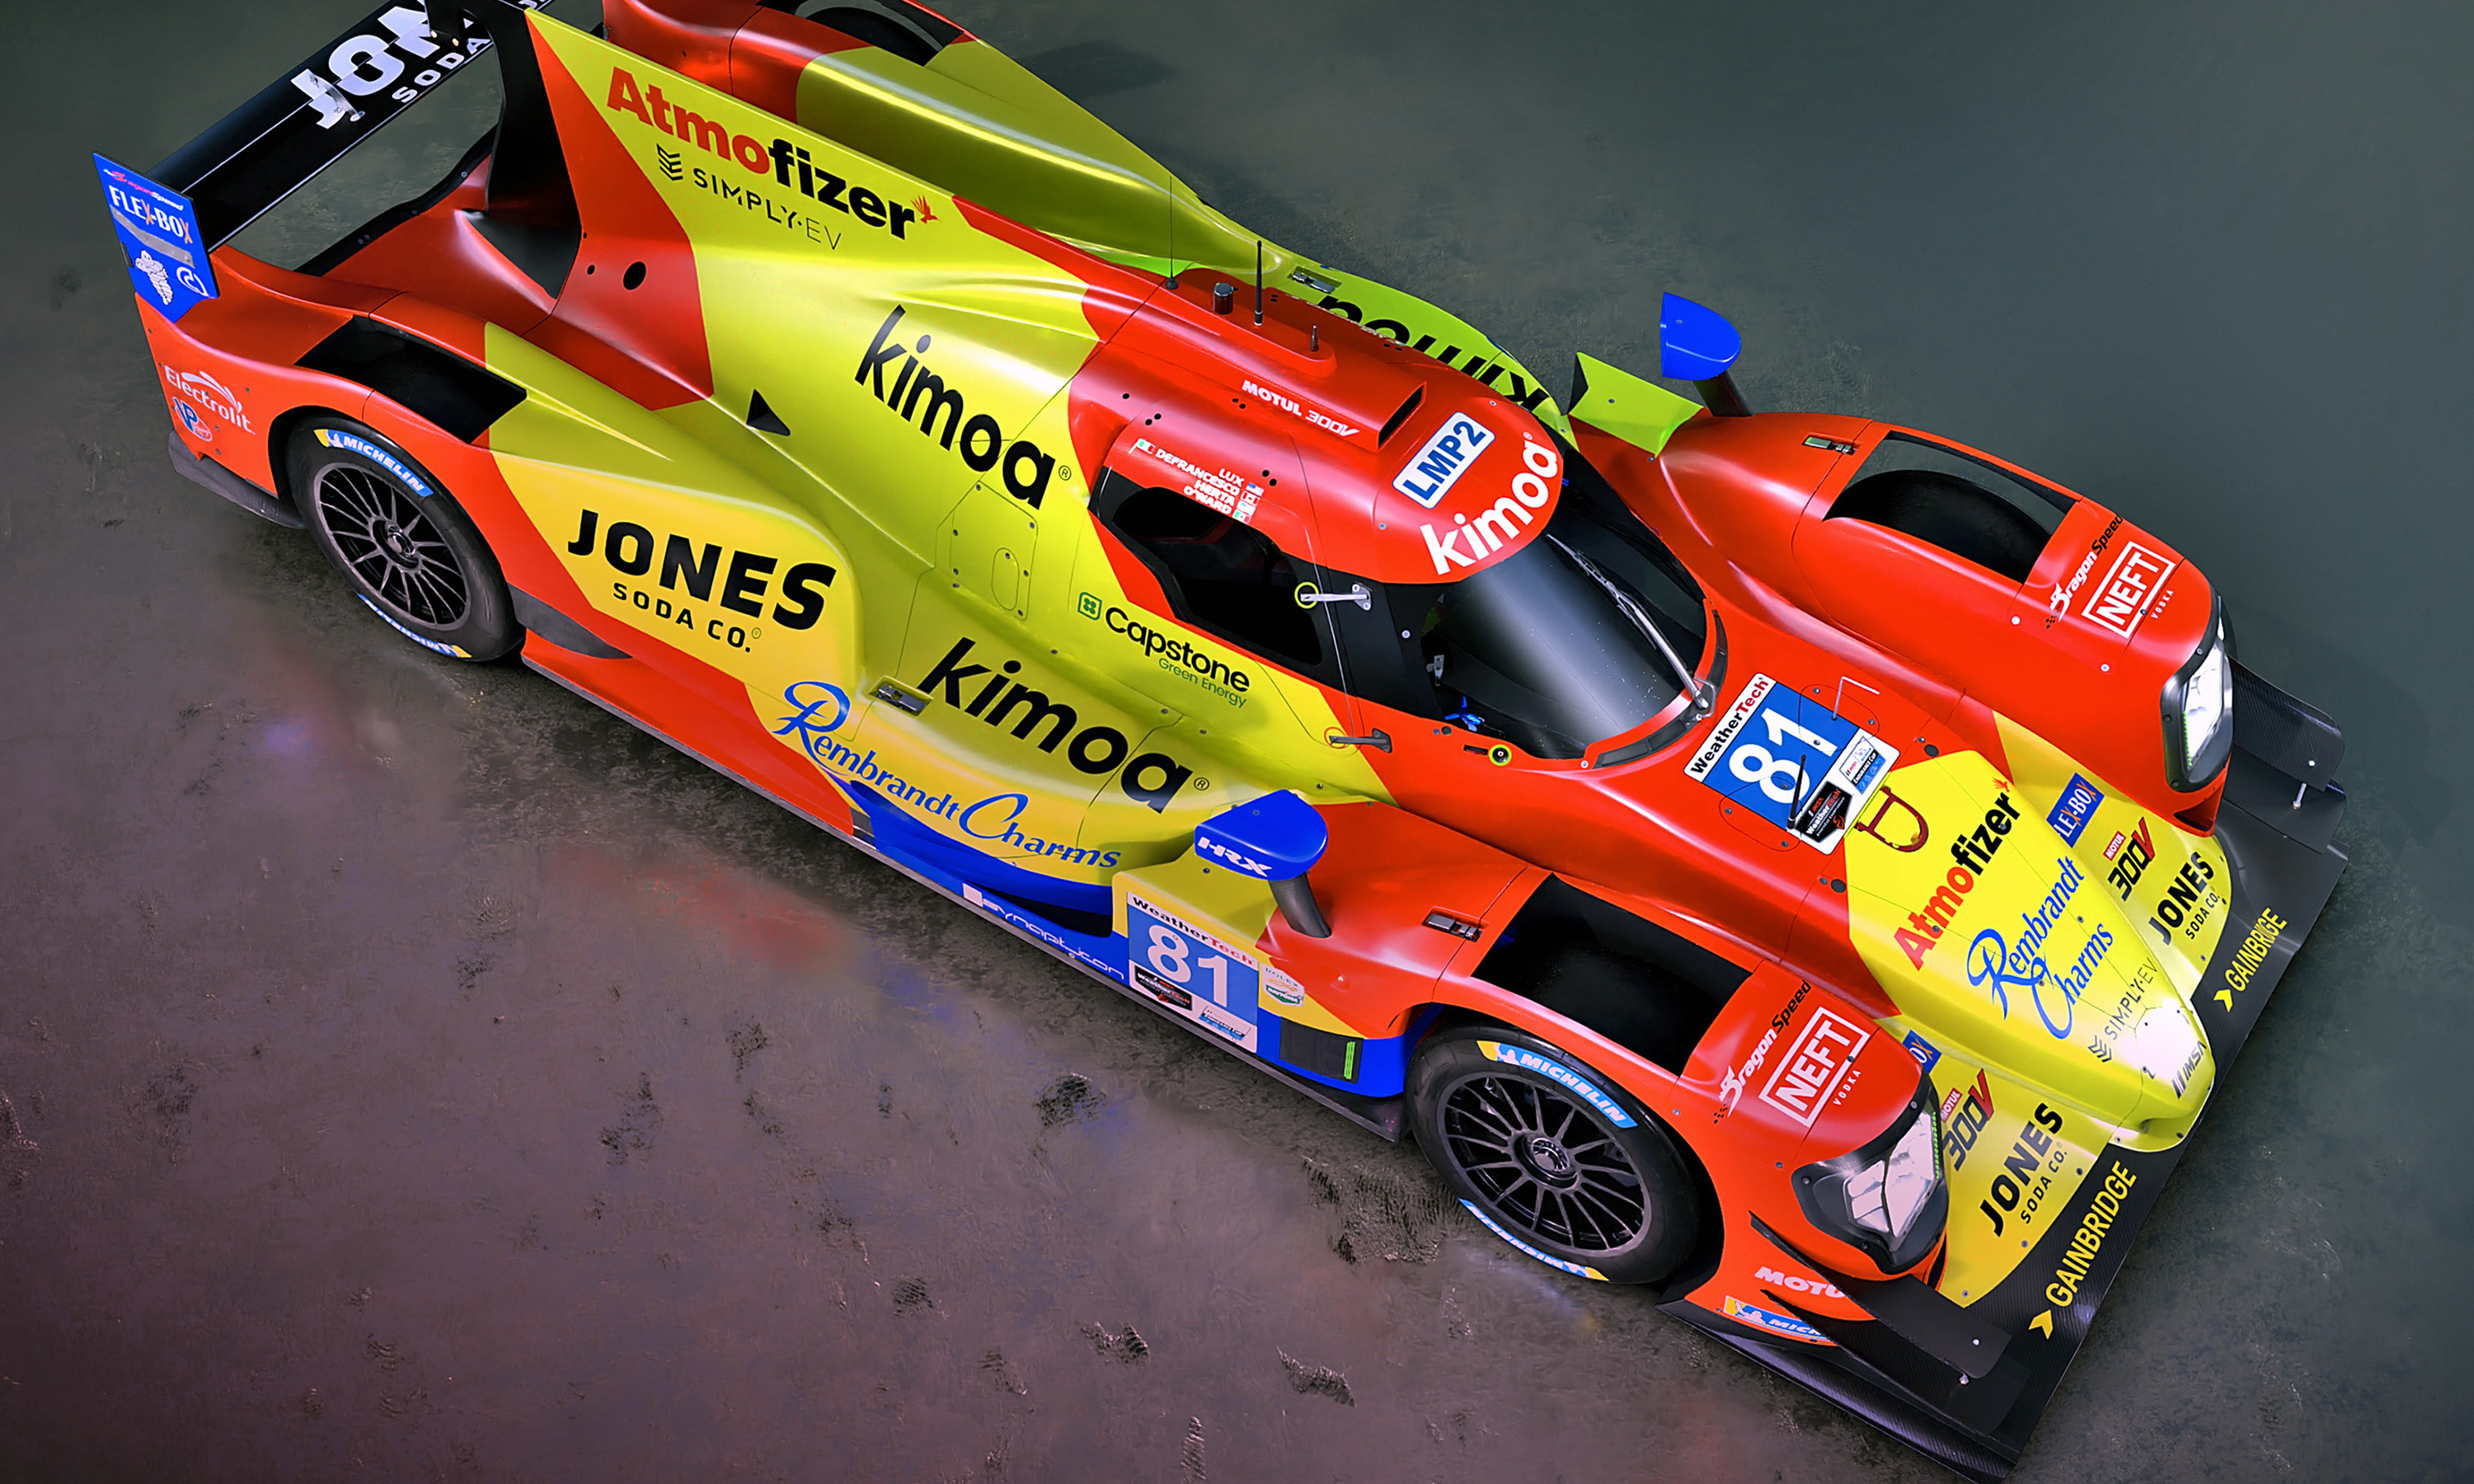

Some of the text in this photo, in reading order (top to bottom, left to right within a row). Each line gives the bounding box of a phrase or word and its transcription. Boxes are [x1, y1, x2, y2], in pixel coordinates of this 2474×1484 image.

[392, 37, 493, 102] SODA
[607, 66, 915, 240] Atmofizer
[109, 185, 193, 244] FLEX-BOX
[165, 365, 256, 435] Electrolit
[172, 397, 199, 433] VP
[854, 304, 1056, 510] kimoa
[1242, 380, 1359, 436] MOTUL 300V
[343, 436, 425, 491] MICHELIN
[1155, 448, 1241, 496] DEFRANCESCO
[1194, 480, 1236, 507] HERTA
[1218, 467, 1245, 488] LUX
[1402, 420, 1486, 501] LMP2
[1420, 439, 1558, 575] kimoa
[568, 509, 837, 630] JONES
[2096, 551, 2159, 626] NEFT
[2151, 589, 2174, 618] VODKA
[613, 582, 751, 653] SODA CO.
[1106, 608, 1250, 693] Capstone
[1158, 658, 1247, 709] Green Energy
[915, 636, 1193, 814] kimoa
[1690, 679, 1770, 776] WeatherTech
[1729, 707, 1838, 805] 81
[772, 681, 1122, 868] Rembrandt Charms
[2053, 780, 2096, 838] LEX-BOX
[1197, 836, 1272, 877] HRX
[1894, 792, 2021, 971] Atmofizer
[2105, 833, 2125, 859] MOTUL
[2107, 816, 2156, 902] 300V
[1133, 896, 1253, 965] WeatherTech
[2148, 852, 2214, 946] JONES
[2185, 892, 2221, 940] SODA CO.
[1148, 924, 1228, 1007] 81
[1967, 856, 2085, 1021] Rembrandt
[2030, 923, 2114, 1040] Charms
[1719, 979, 1811, 1118] DragonSpeed
[1775, 1020, 1851, 1112] NEFT
[1520, 1053, 1627, 1121] MICHELIN
[1833, 1070, 1861, 1106] VODKA
[1941, 1091, 1960, 1121] MOTUL
[1942, 1068, 1994, 1172] 300V
[1980, 1102, 2063, 1237] JONES
[2021, 1149, 2068, 1224] SODA CO.
[2045, 1160, 2137, 1307] GAINBRIDGE
[1753, 1266, 1847, 1298] MOTU
